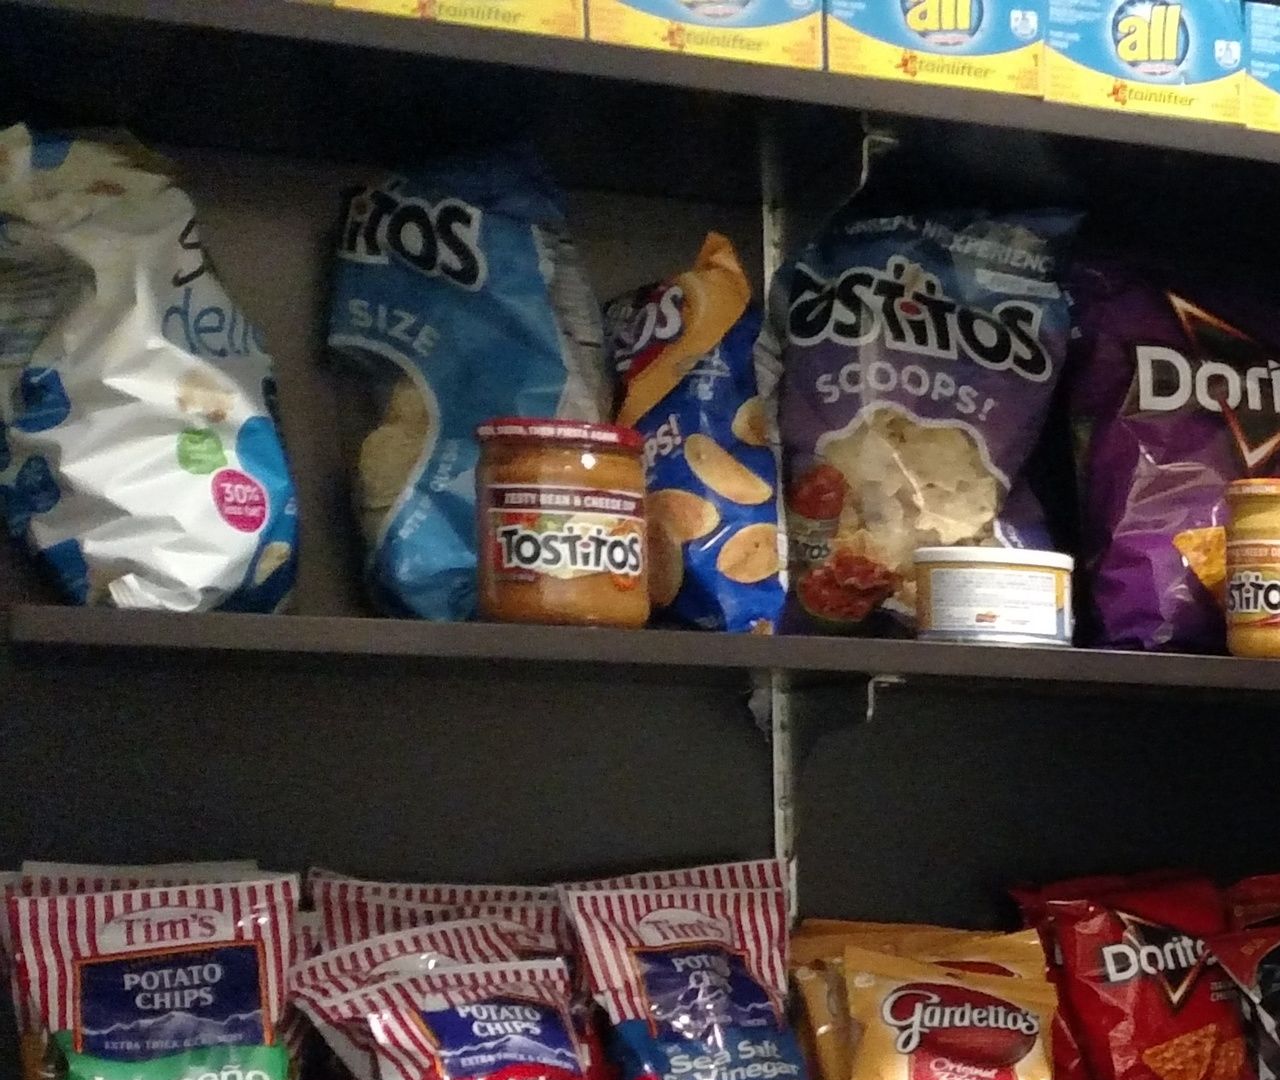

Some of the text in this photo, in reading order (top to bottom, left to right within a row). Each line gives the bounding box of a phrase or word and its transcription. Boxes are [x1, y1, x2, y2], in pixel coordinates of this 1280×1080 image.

[1115, 3, 1181, 62] all
[348, 298, 441, 358] SIZE
[815, 360, 995, 421] SCOOPS!
[122, 912, 217, 946] Tim's
[122, 963, 224, 991] POTATO
[135, 985, 214, 1010] CHIPS
[456, 1004, 542, 1023] POTATO
[470, 1019, 543, 1038] CHIPS
[882, 989, 1040, 1055] Gardetto's
[668, 1039, 782, 1075] Sea Salt
